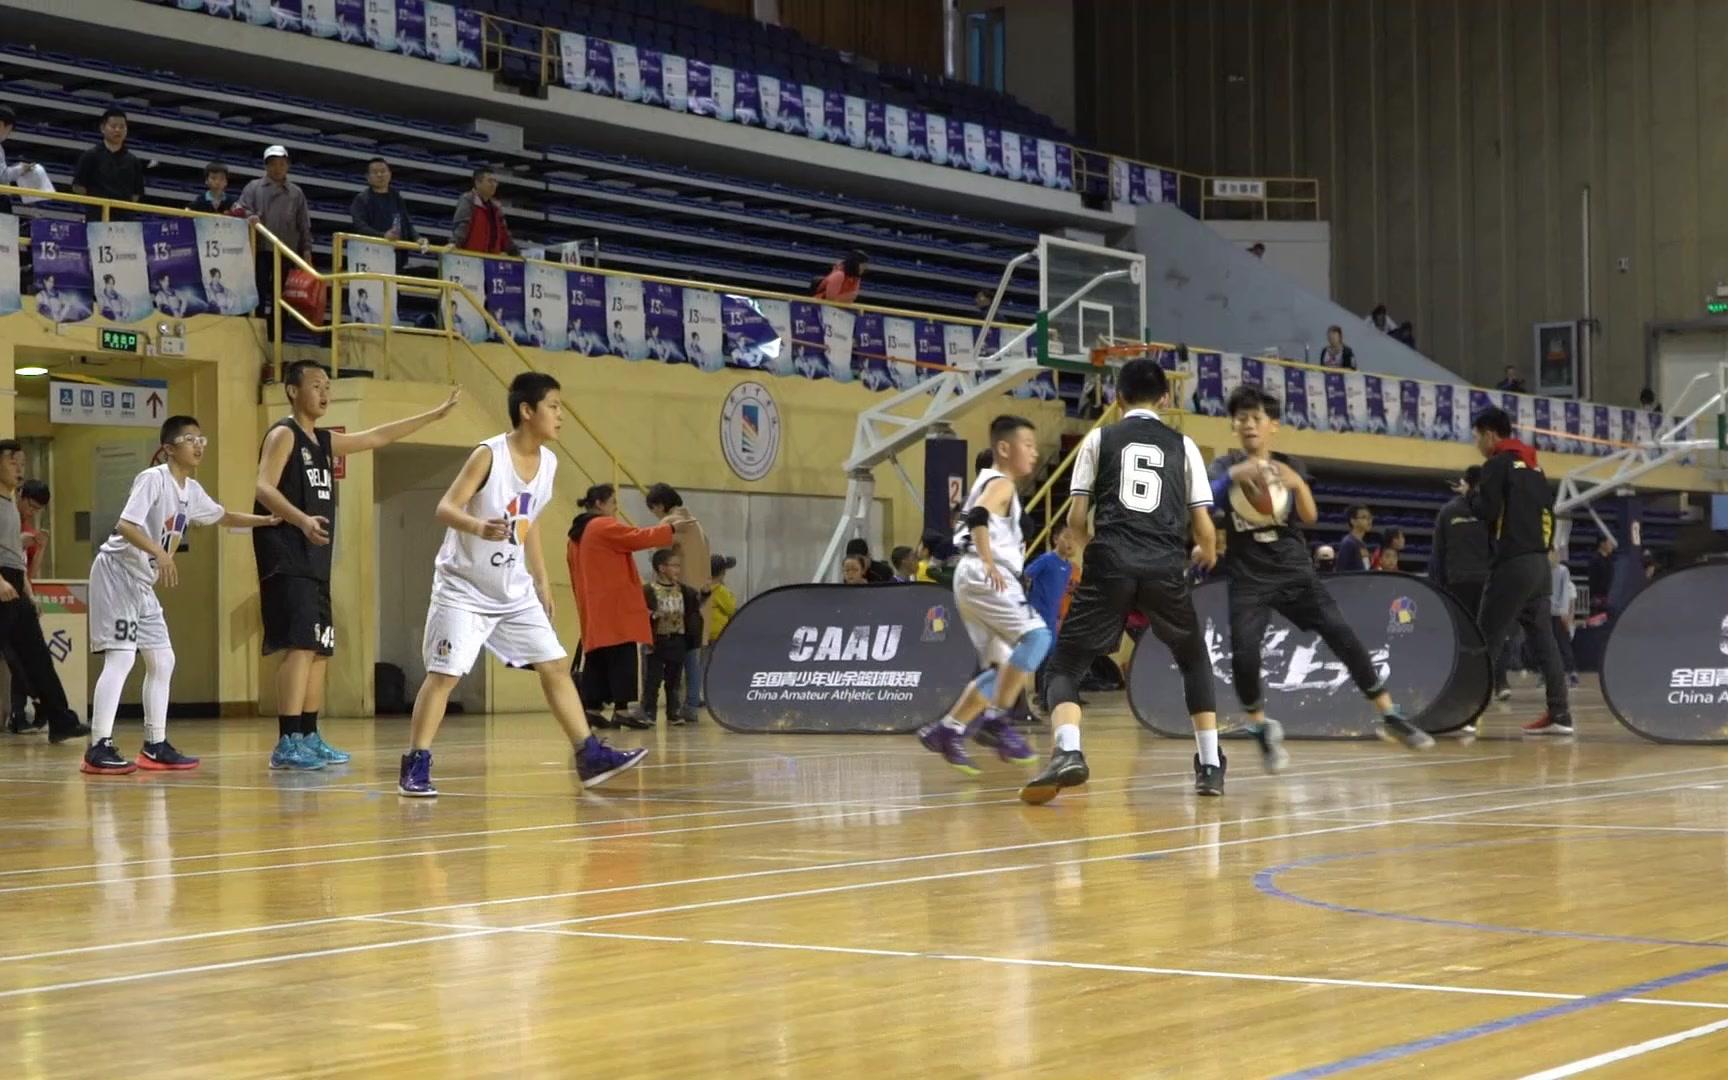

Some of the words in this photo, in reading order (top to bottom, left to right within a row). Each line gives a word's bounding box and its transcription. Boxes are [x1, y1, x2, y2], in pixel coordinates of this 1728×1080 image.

[40, 241, 57, 260] 13
[98, 246, 113, 264] 13
[153, 242, 169, 260] 13
[205, 240, 219, 257] 13
[492, 278, 505, 295] 13
[530, 283, 542, 299] 13
[571, 290, 584, 306] 13
[611, 297, 623, 312] 13
[688, 308, 700, 324] 13
[1119, 442, 1165, 513] 6
[950, 480, 960, 505] 2
[115, 619, 138, 642] 93
[788, 624, 904, 662] CAAU
[750, 671, 922, 688] 全国青少年业余篮球联赛
[746, 689, 778, 700] China
[779, 689, 829, 701] Amateur
[831, 688, 875, 701] Athletic
[878, 689, 913, 701] Union
[1667, 690, 1714, 704] China
